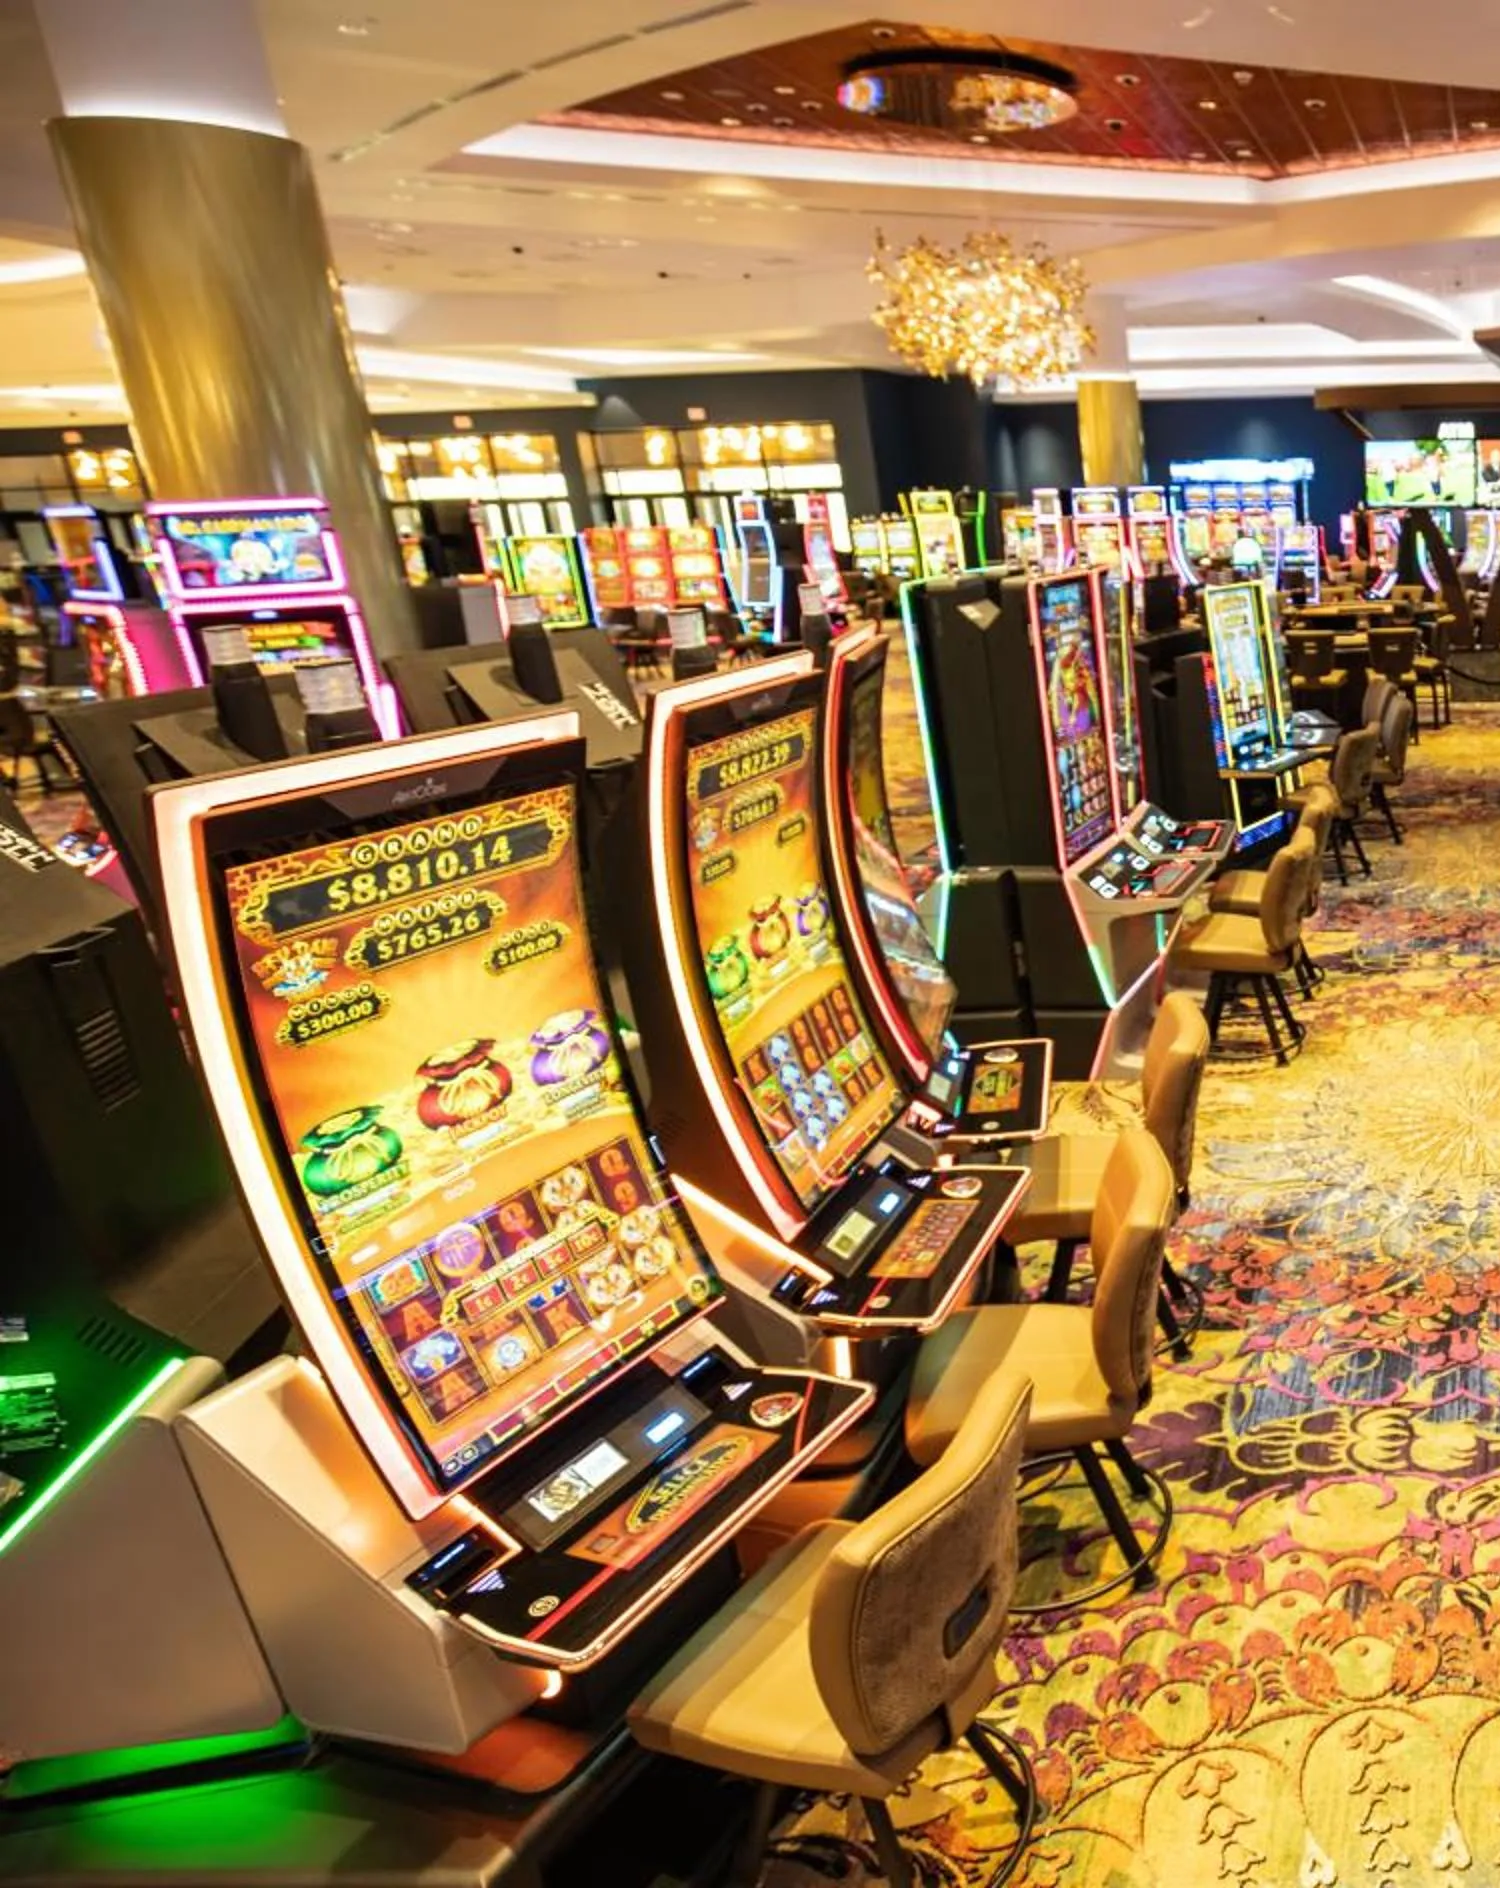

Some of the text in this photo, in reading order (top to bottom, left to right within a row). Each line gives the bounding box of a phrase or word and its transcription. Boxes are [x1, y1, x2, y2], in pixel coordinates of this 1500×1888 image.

[355, 818, 481, 866] GRAND
[327, 835, 512, 911] $8,810.14
[377, 911, 480, 960] $765.26
[297, 1001, 374, 1039] $300.00
